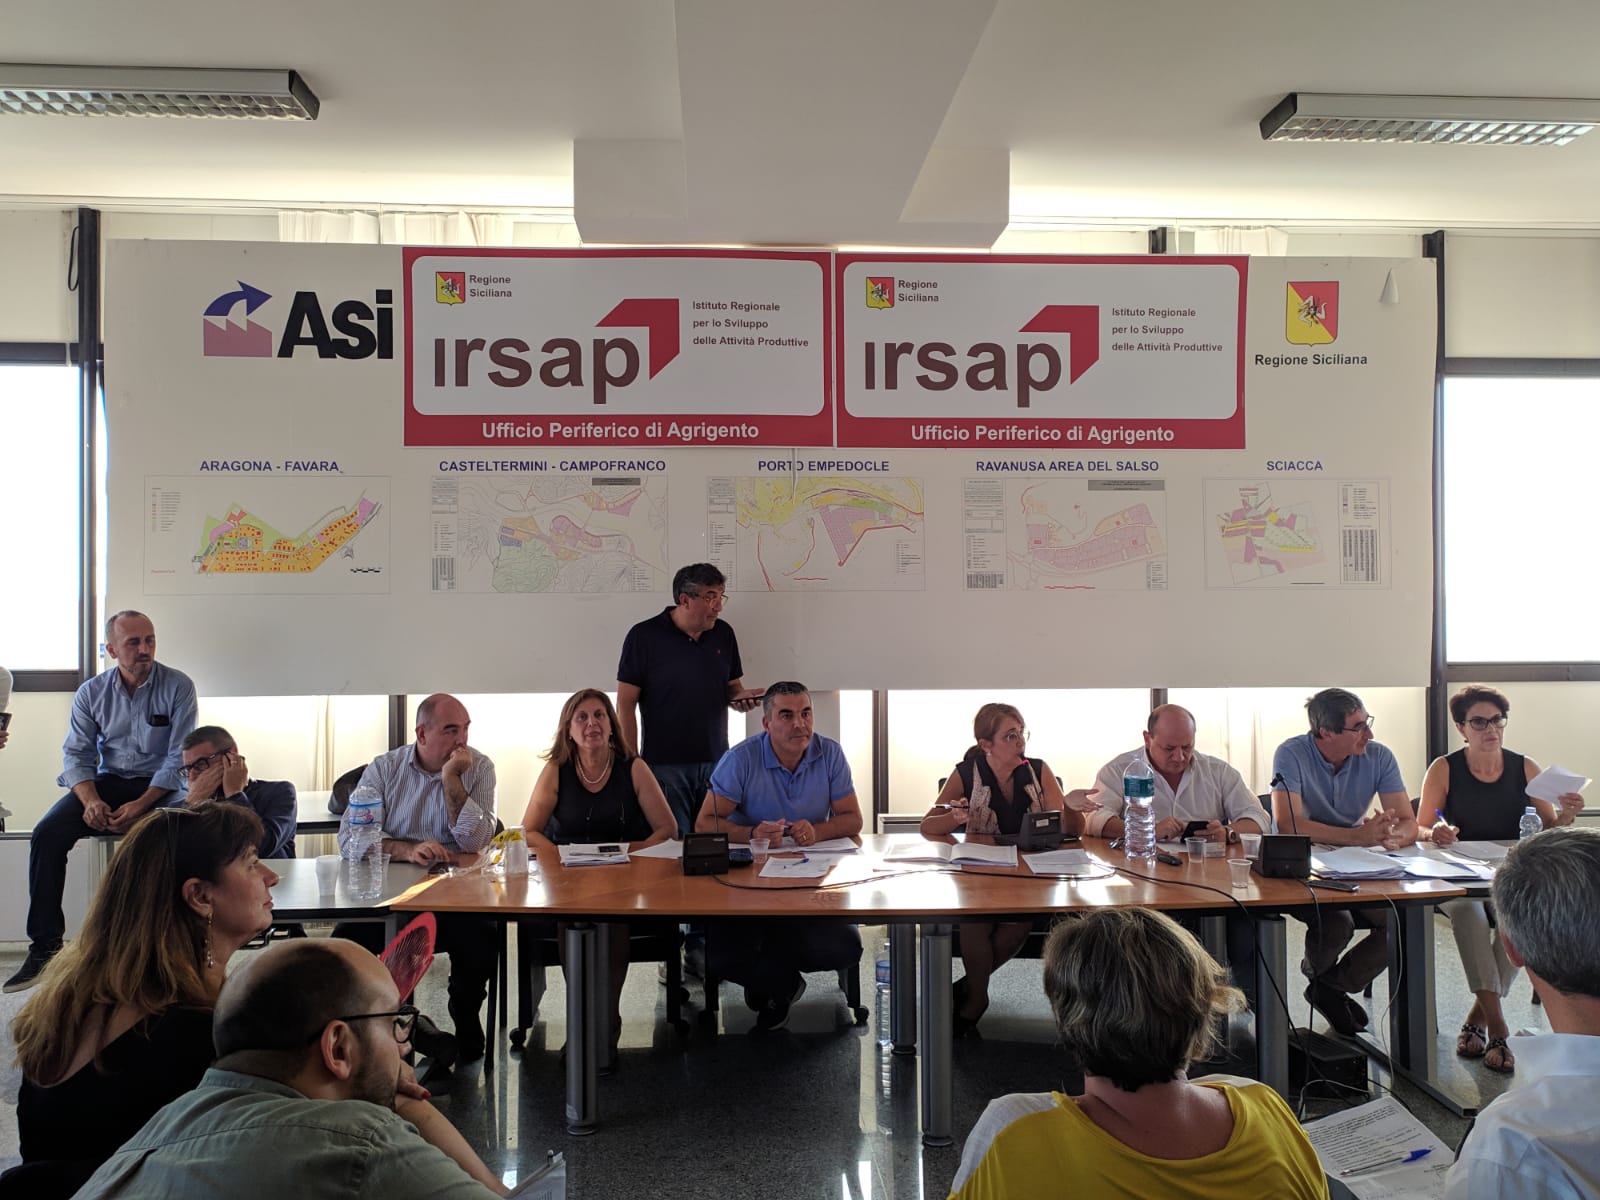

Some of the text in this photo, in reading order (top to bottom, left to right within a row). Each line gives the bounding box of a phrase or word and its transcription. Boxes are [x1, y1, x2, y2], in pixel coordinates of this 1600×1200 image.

[469, 274, 511, 287] Regione
[898, 279, 938, 291] Regione
[469, 287, 512, 299] Siciliana
[898, 292, 939, 302] Siciliana
[692, 300, 781, 313] Istituto Regionale
[1112, 307, 1196, 319] Istituto Regionale
[277, 289, 394, 360] Asi
[692, 318, 769, 331] per lo Sviluppo
[1111, 324, 1185, 336] per lo Sviluppo
[692, 335, 809, 347] delle Attività Produttive
[1111, 342, 1223, 352] delle Attività Produttive
[1254, 353, 1368, 368] Regione Siciliana
[482, 421, 760, 443] Ufficio Periferico di Agrigento
[911, 424, 1175, 445] Ufficio Periferico di Agrigento
[199, 460, 273, 472] ARAGONA
[284, 460, 340, 472] FAVARA
[439, 460, 548, 472] CASTELTERMINI
[559, 460, 666, 472] CAMPOFRANCO
[808, 460, 889, 472] EMPEDOCLE
[976, 460, 1159, 472] RAVANUSA AREA DEL SALSO
[1266, 460, 1323, 472] SCIACCA
